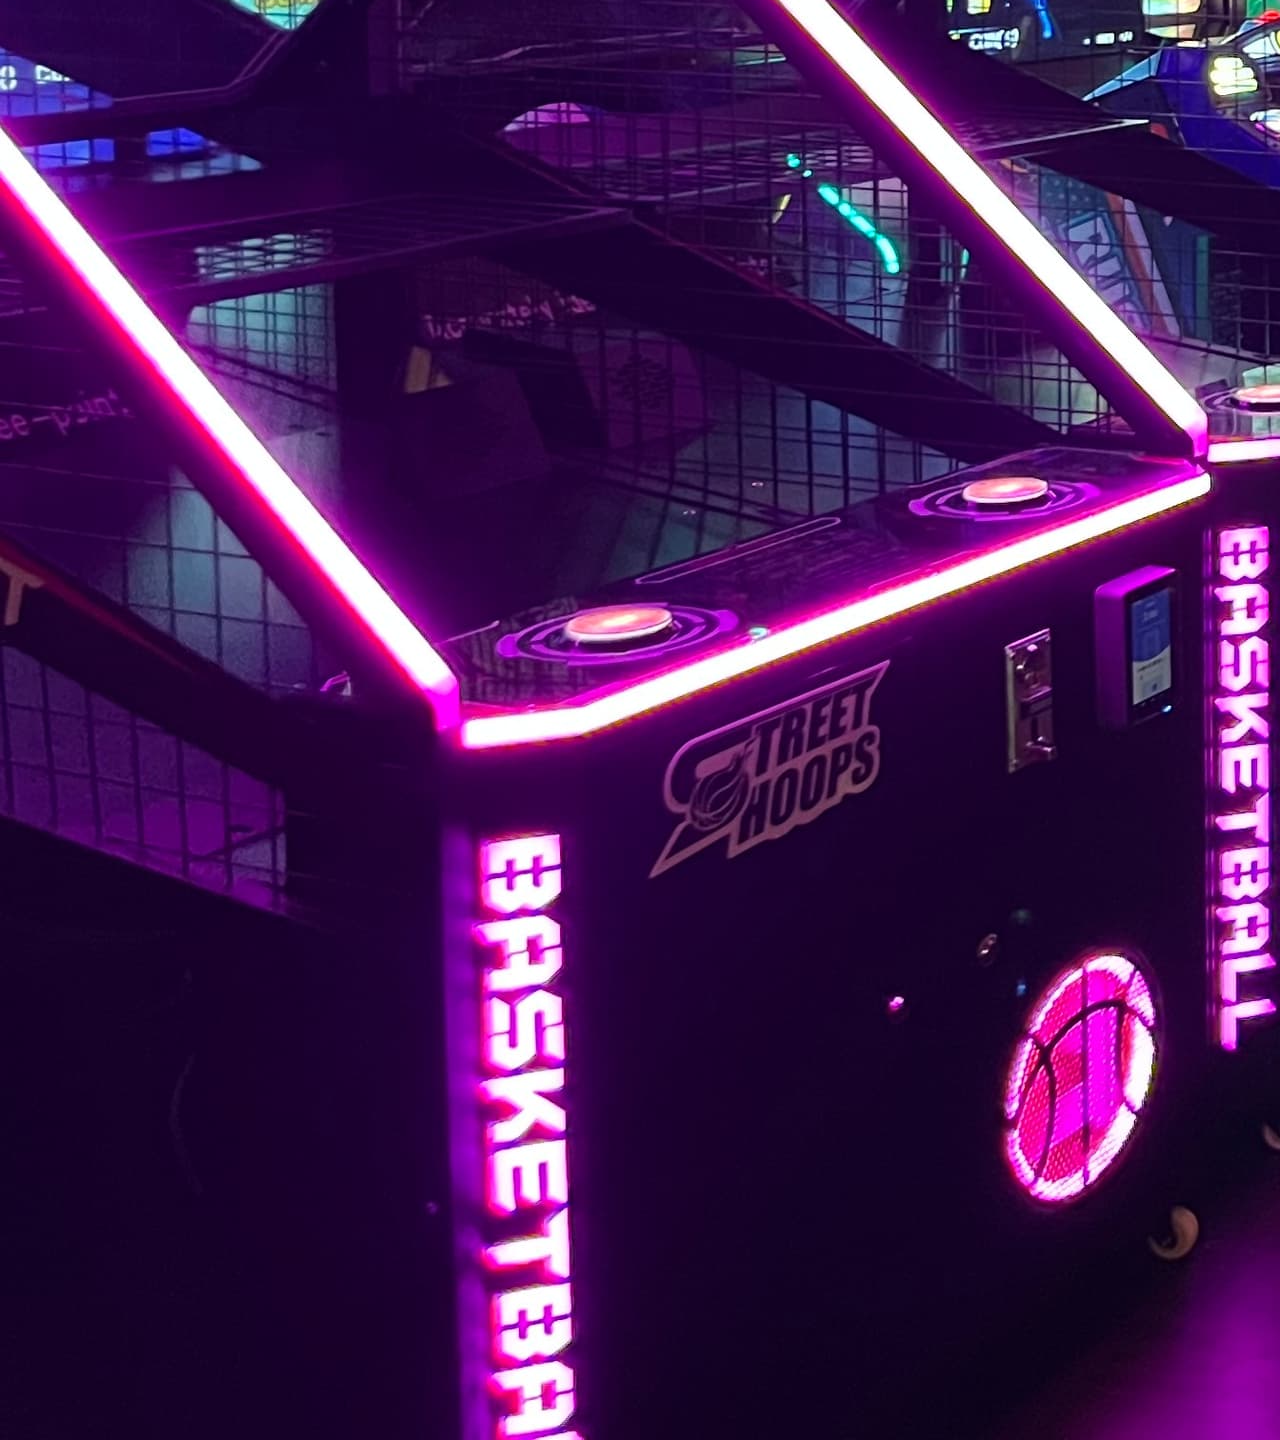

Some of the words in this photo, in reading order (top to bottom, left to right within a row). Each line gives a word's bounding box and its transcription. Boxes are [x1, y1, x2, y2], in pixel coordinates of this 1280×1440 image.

[737, 731, 879, 846] HOOPS
[1214, 525, 1277, 1052] BASKETBALL
[474, 832, 582, 1440] BASKETBA
